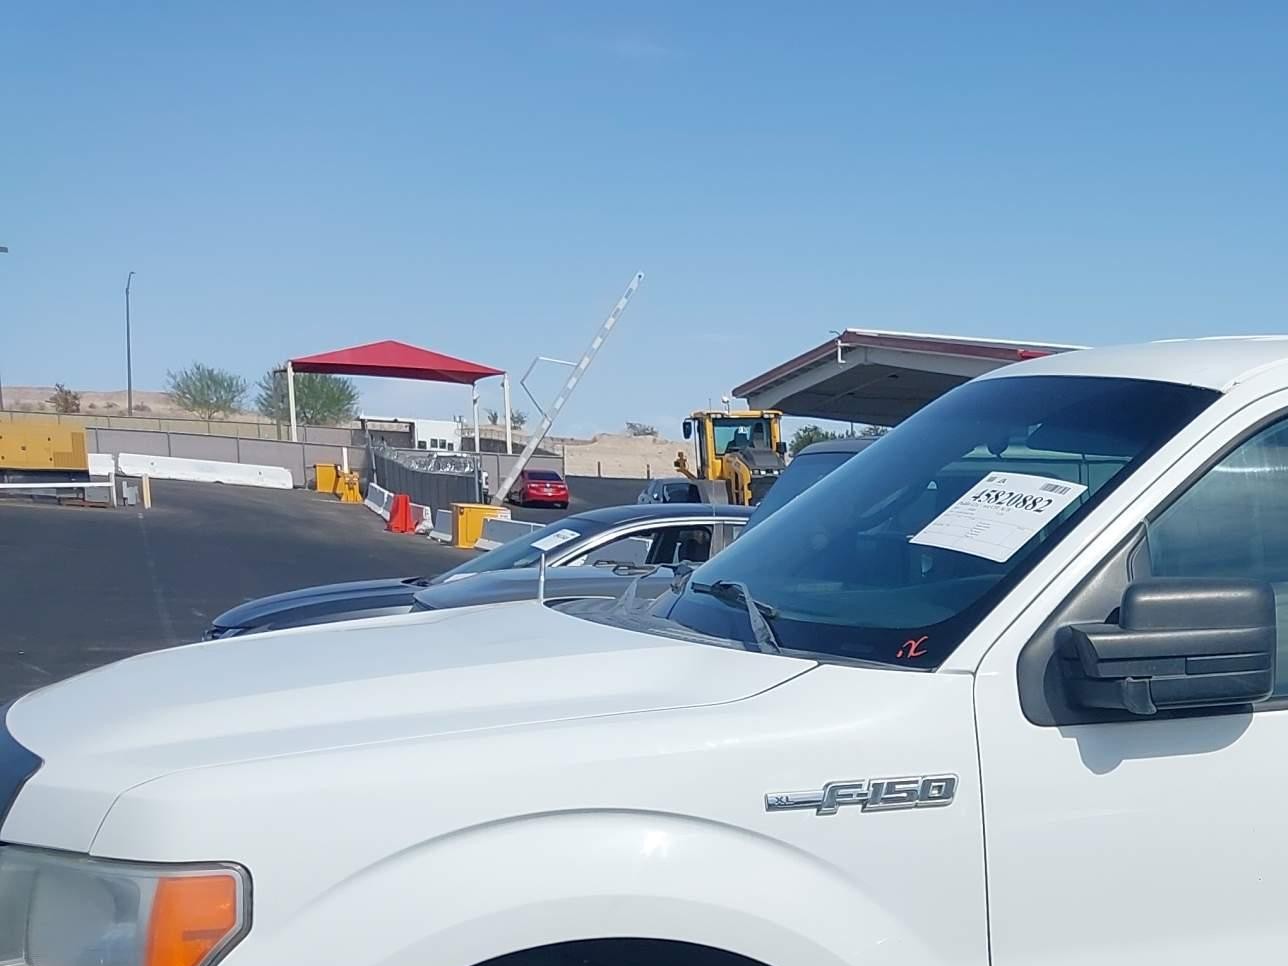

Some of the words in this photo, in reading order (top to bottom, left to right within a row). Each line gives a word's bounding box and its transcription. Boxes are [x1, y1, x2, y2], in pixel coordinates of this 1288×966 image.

[972, 488, 1053, 513] 45820882
[774, 795, 796, 806] XL
[815, 773, 960, 817] F-150
